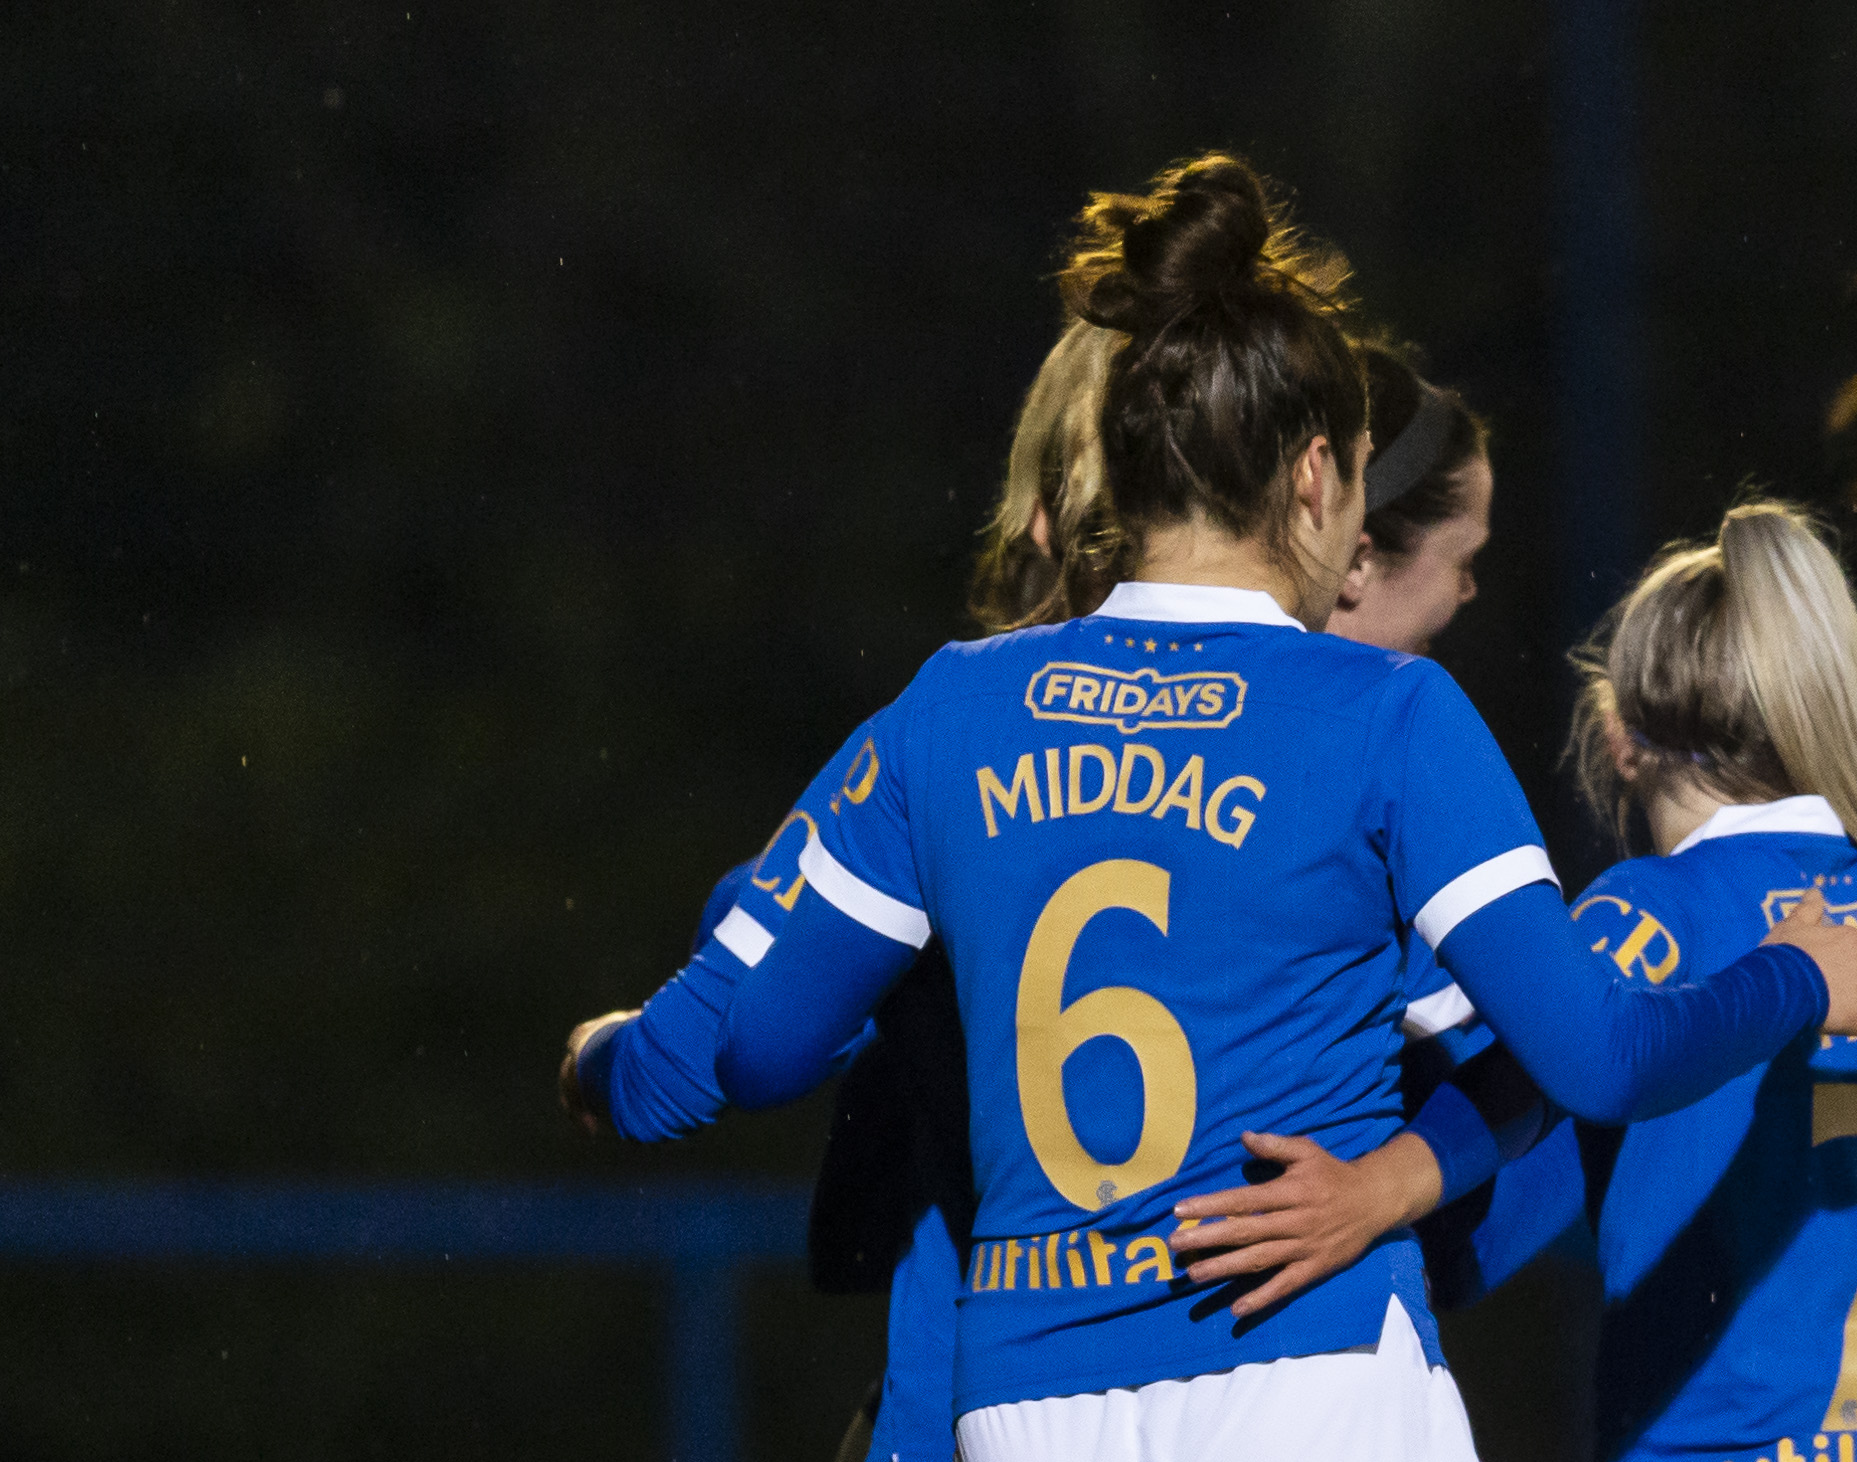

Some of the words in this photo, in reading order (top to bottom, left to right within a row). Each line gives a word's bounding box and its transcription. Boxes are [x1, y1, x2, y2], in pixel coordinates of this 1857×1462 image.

[1041, 673, 1226, 717] FRIDAYS
[975, 742, 1267, 850] MIDDAG
[1015, 857, 1197, 1213] 6
